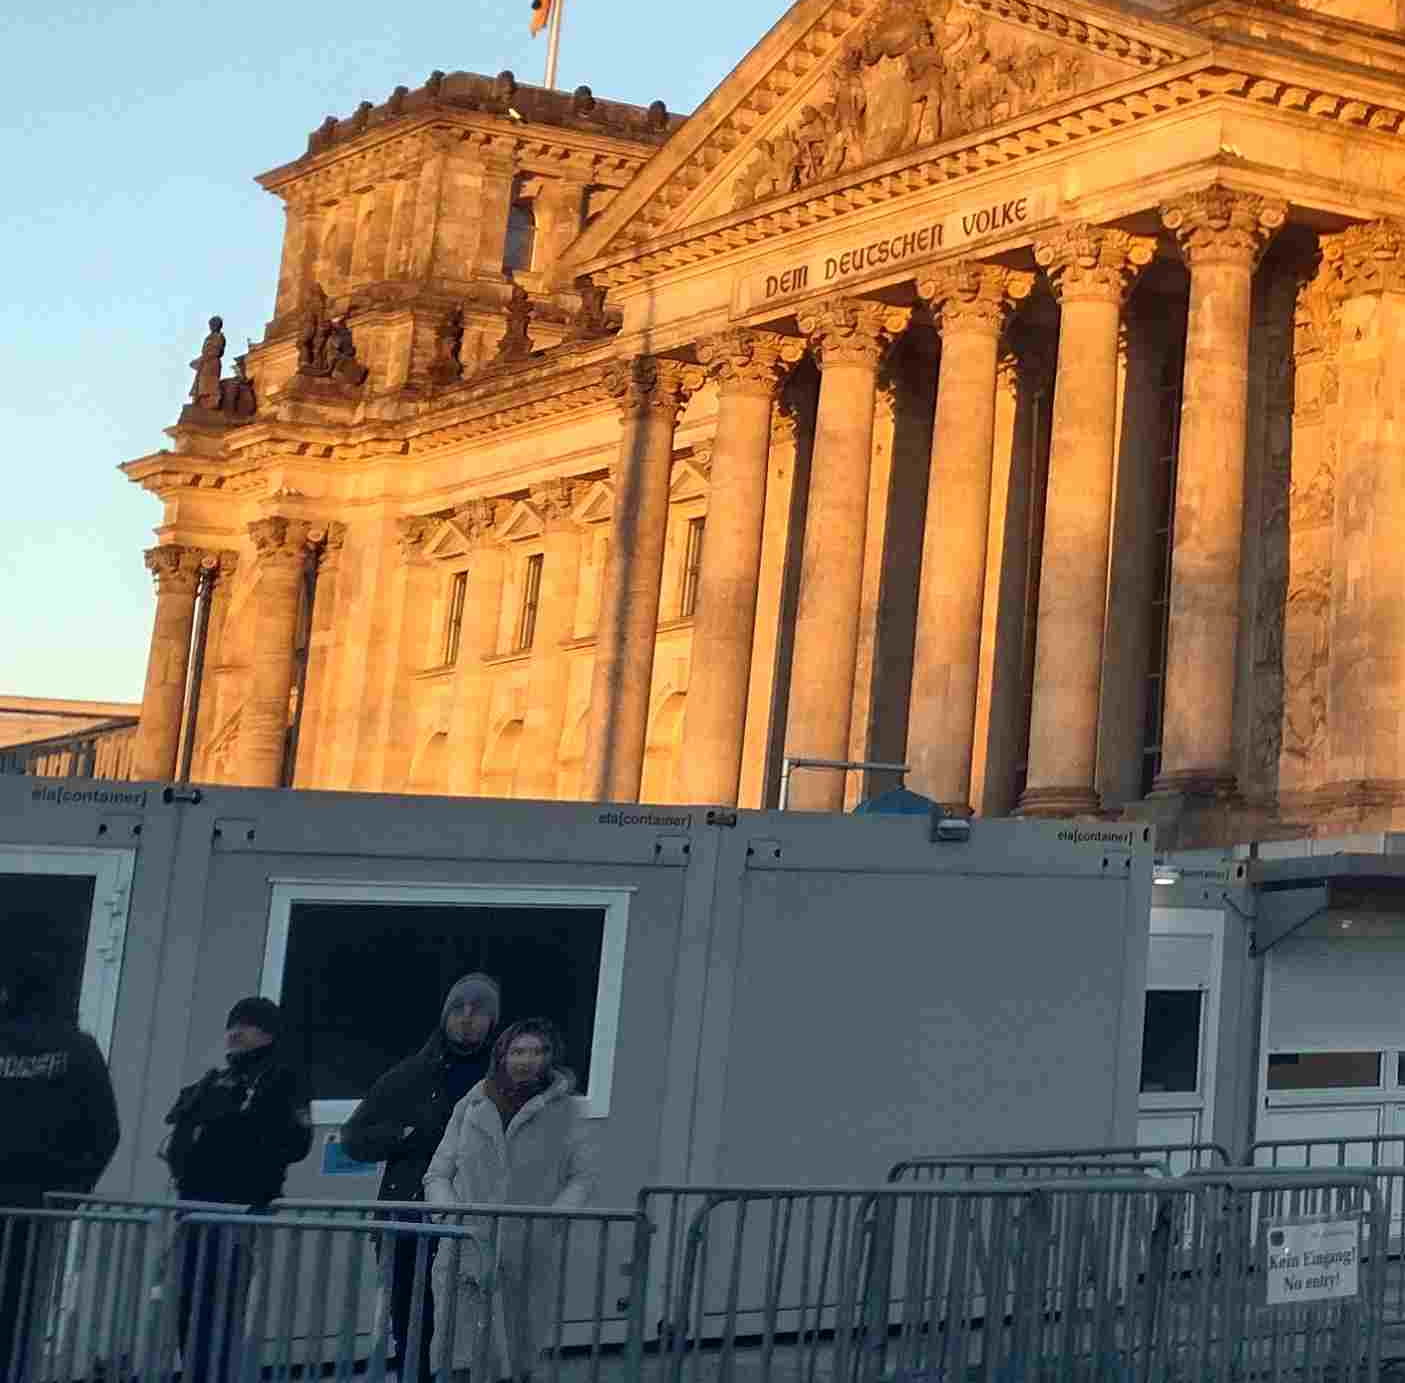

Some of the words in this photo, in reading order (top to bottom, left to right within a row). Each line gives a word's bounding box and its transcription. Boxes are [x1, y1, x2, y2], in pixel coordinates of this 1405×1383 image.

[765, 264, 809, 298] DEM
[824, 223, 944, 280] DEUTSCHEN
[962, 197, 1029, 237] VOLKE
